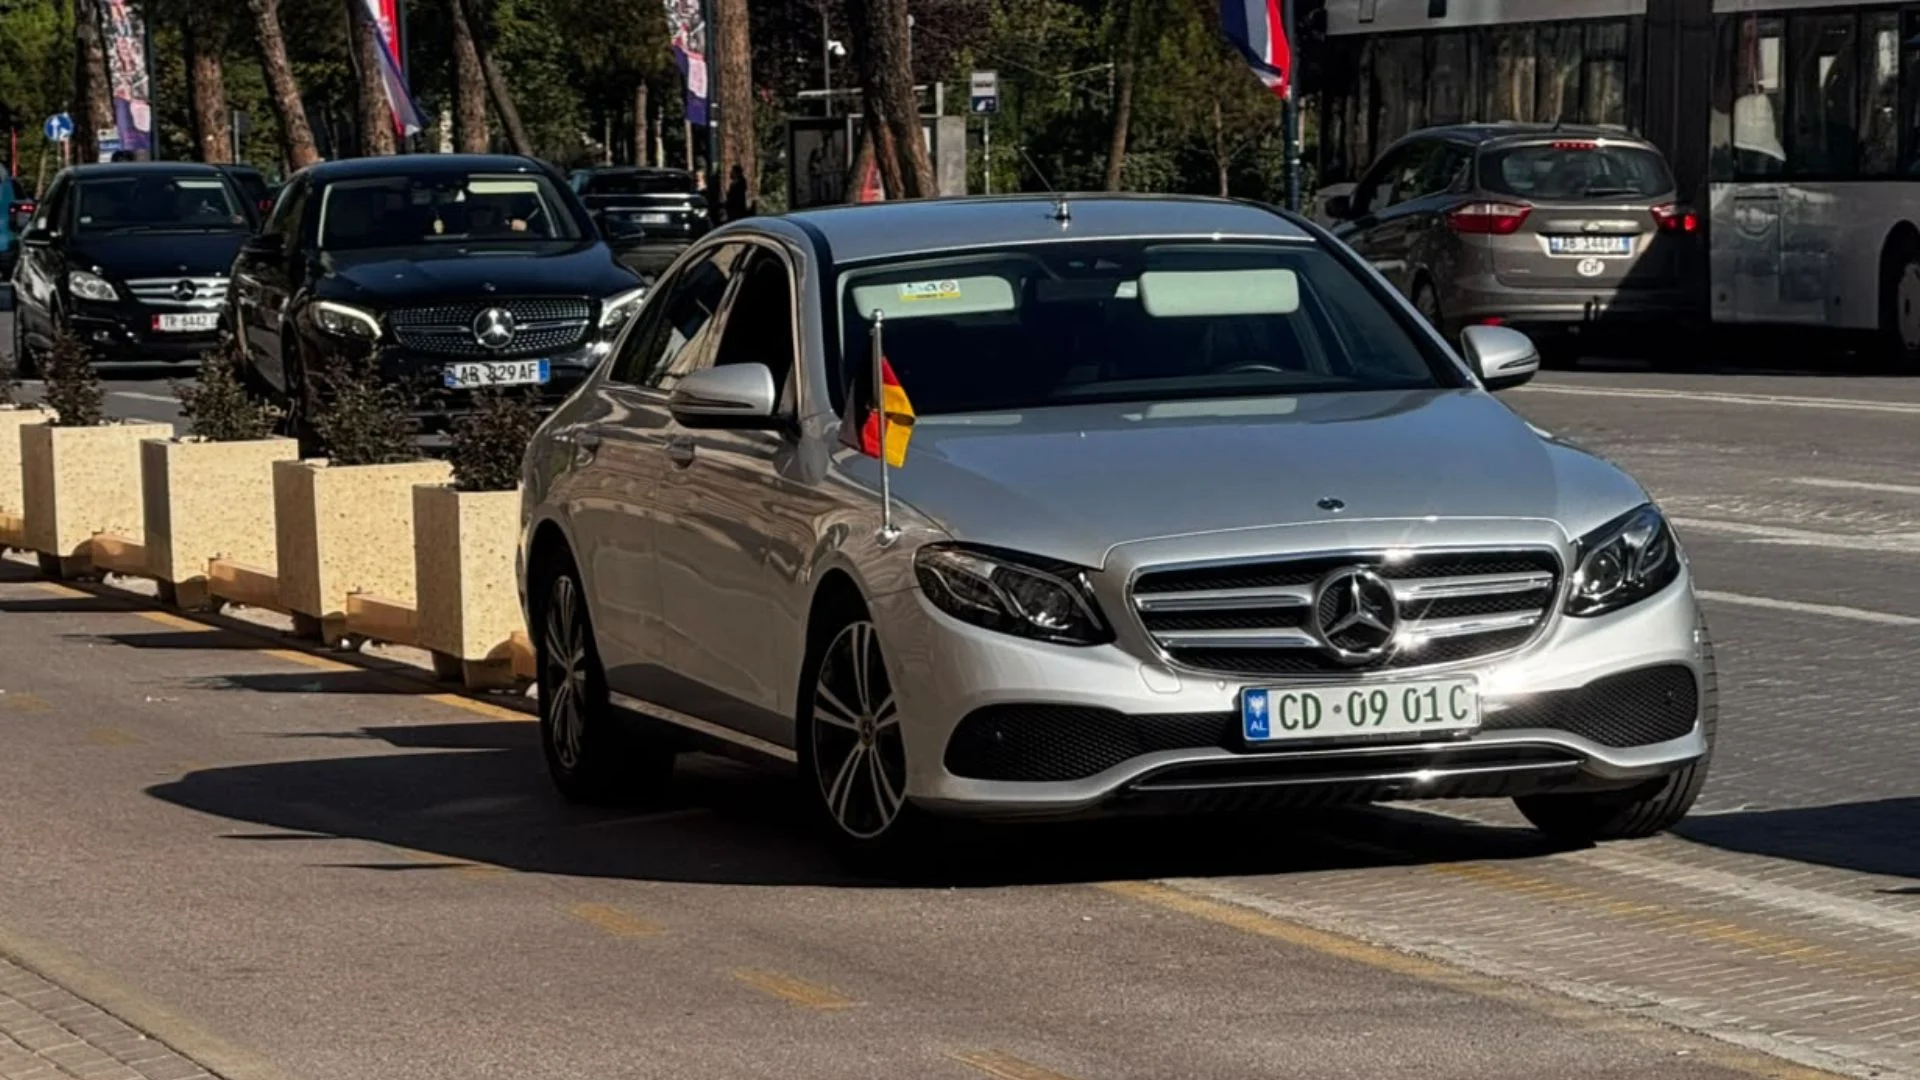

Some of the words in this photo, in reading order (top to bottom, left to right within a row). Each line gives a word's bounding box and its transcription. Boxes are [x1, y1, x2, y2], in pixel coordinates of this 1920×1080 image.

[519, 363, 537, 380] AF
[1279, 692, 1322, 730] CD
[1347, 689, 1388, 727] 09
[1250, 720, 1267, 731] AL
